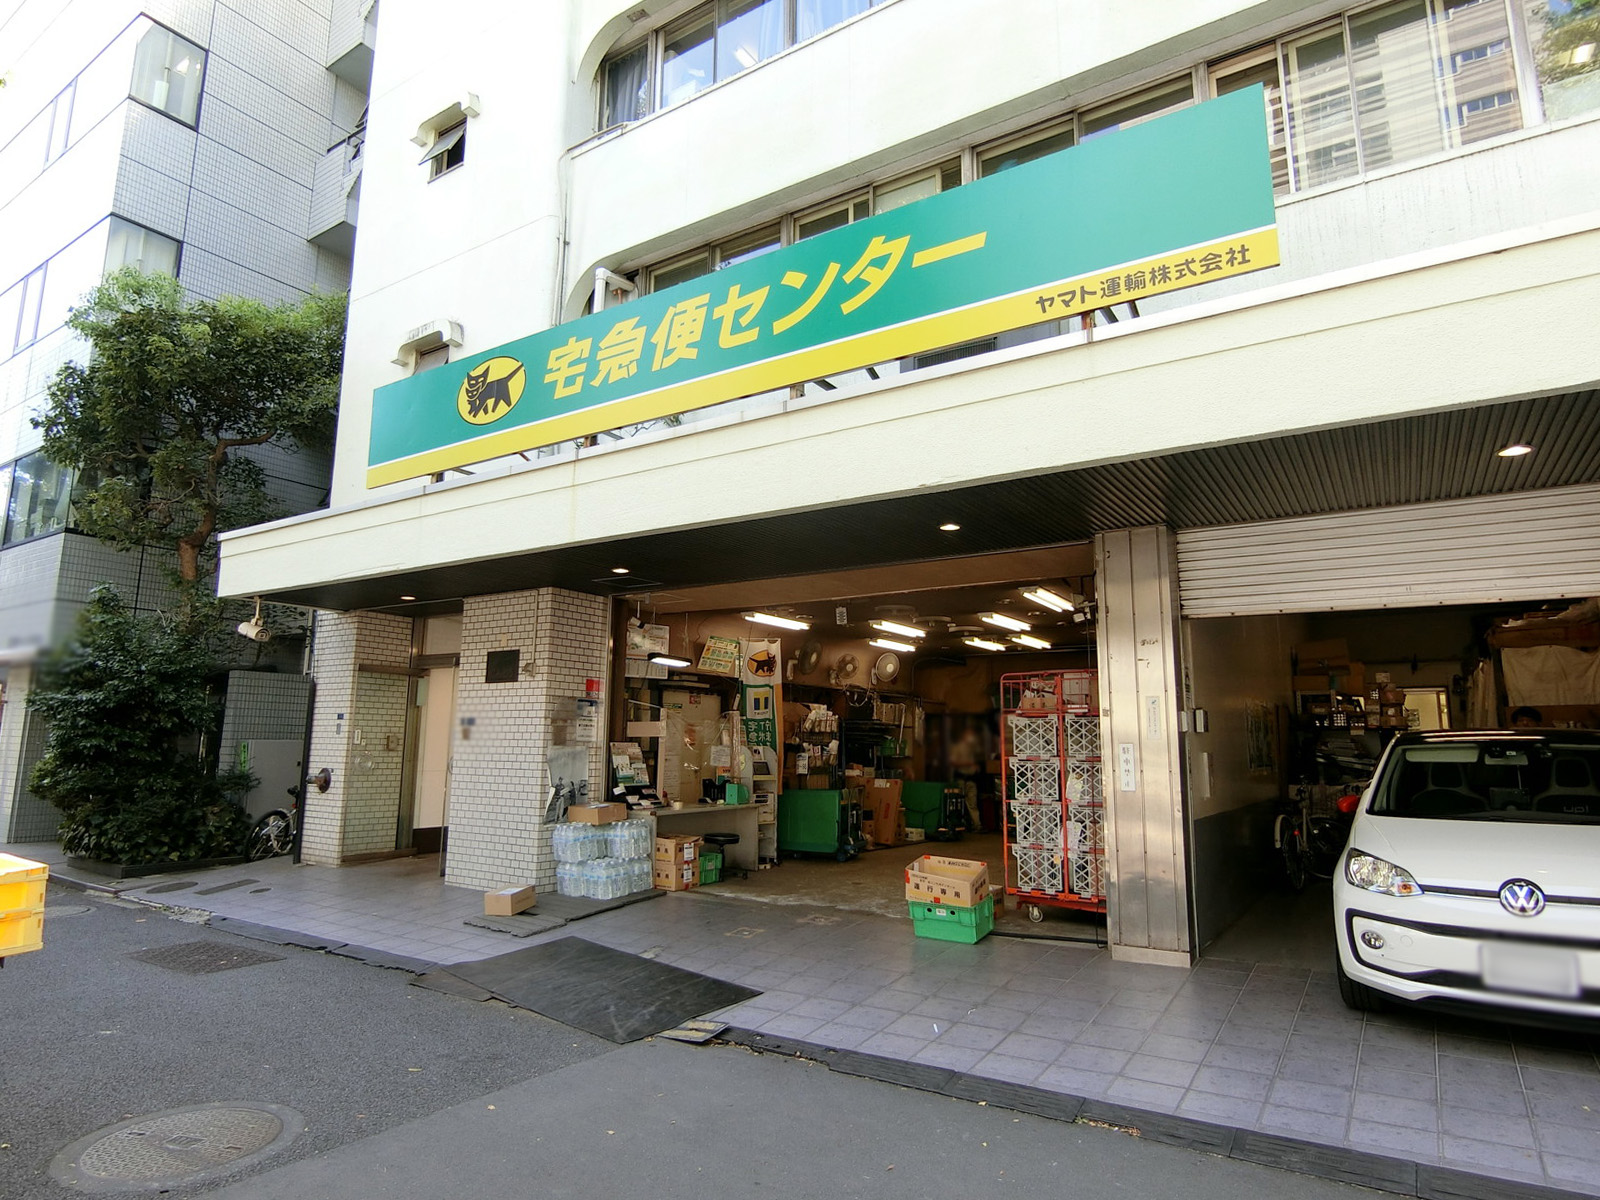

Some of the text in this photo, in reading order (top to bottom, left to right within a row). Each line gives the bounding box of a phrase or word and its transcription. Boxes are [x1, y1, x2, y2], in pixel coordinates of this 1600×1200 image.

[544, 231, 987, 399] 宅急便センター
[1036, 244, 1251, 313] ヤマト運輸株式会社
